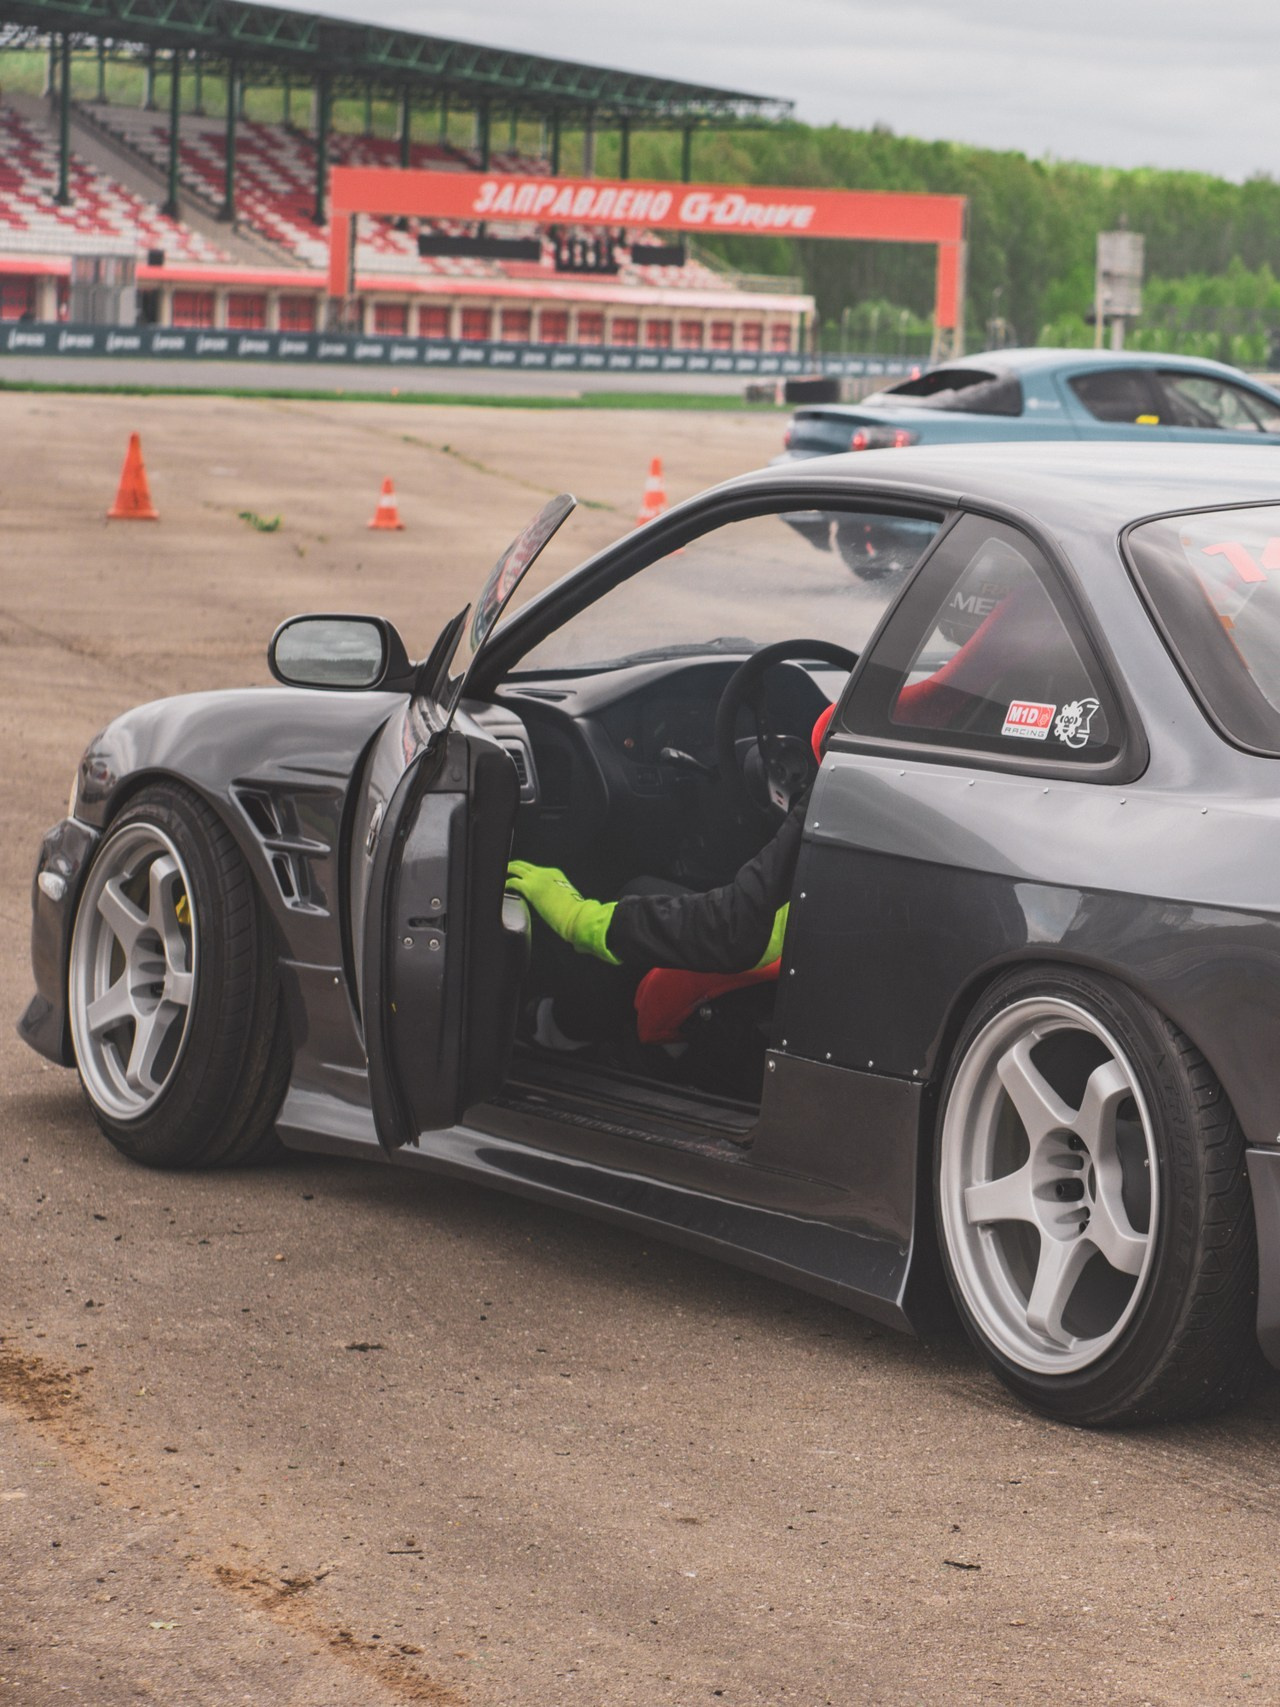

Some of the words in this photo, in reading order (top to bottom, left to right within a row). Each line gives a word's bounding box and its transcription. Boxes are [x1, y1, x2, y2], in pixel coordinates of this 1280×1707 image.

[473, 182, 673, 222] ЗАПРАВЛЕНО
[1009, 706, 1039, 724] M1D
[1004, 727, 1046, 738] RACING
